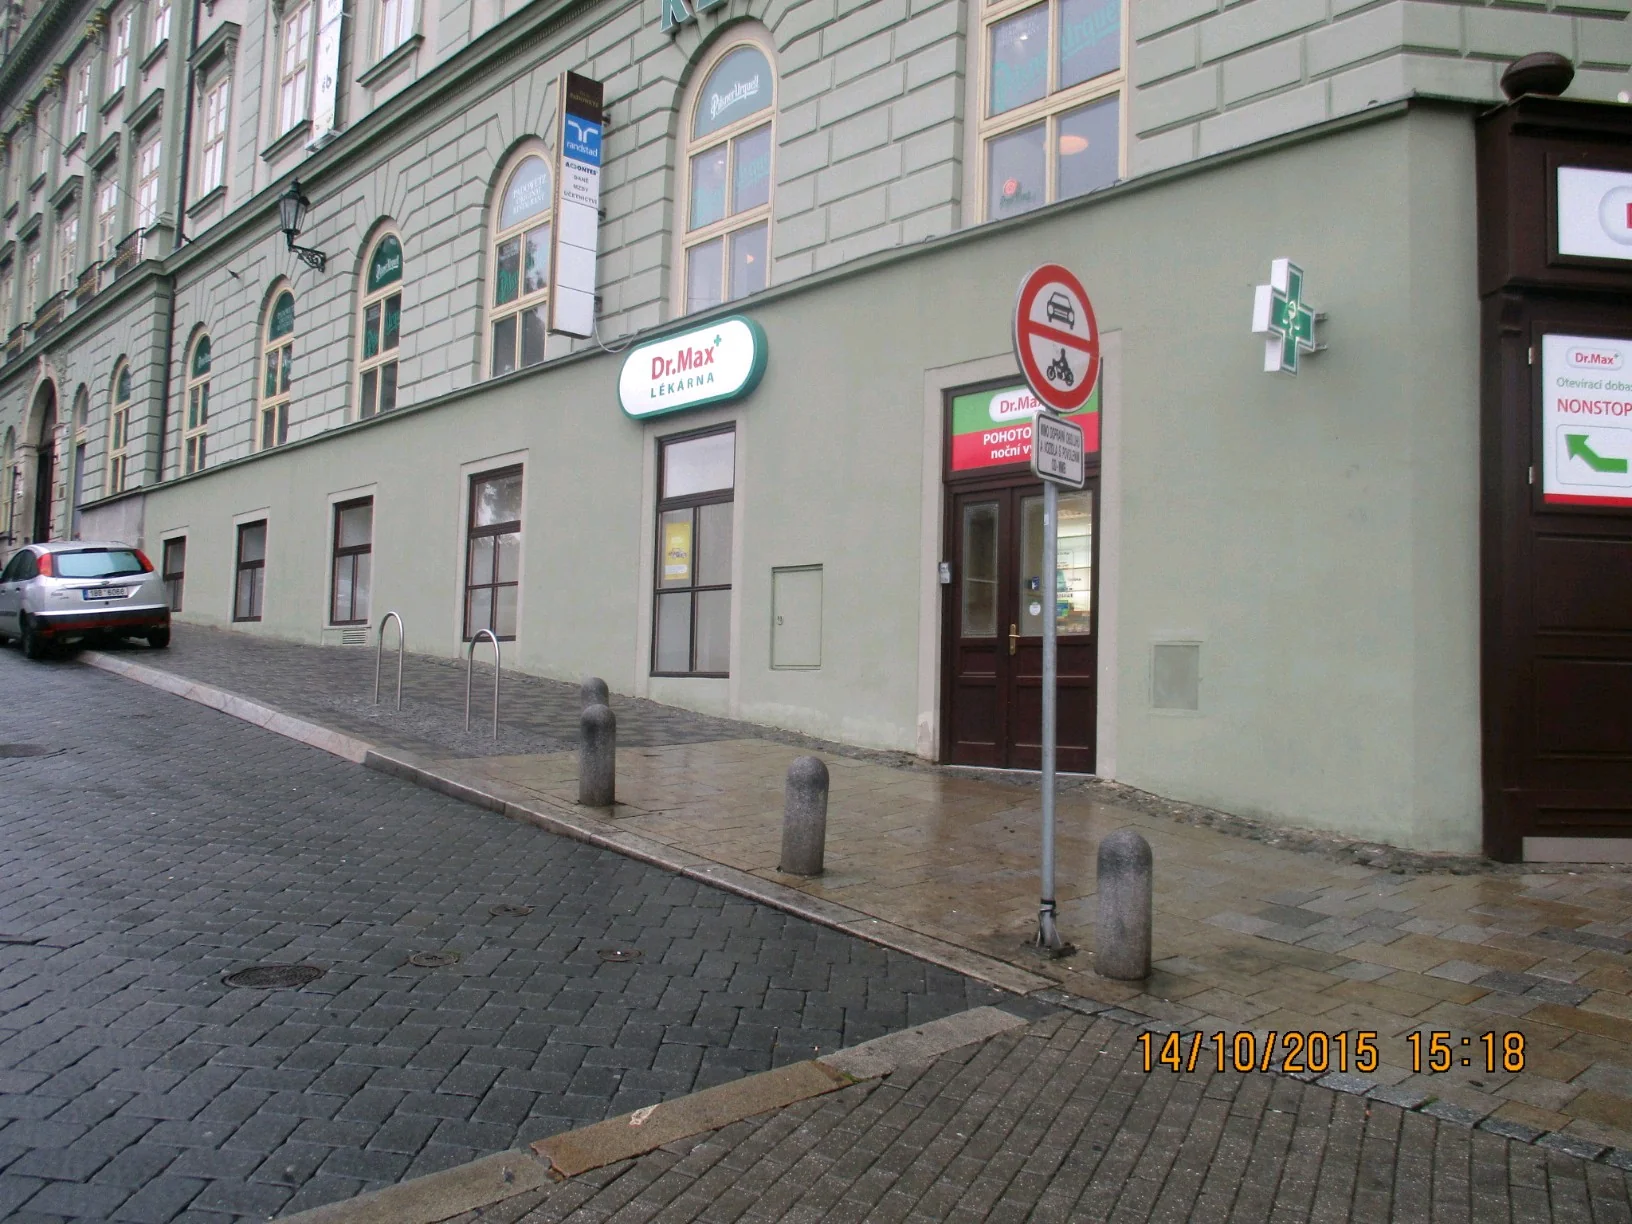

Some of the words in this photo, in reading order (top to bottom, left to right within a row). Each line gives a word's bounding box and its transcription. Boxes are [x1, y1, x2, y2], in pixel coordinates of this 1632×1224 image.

[566, 141, 598, 157] randstad
[651, 346, 715, 380] Dr.Max
[1575, 352, 1615, 365] Dr.Max
[650, 372, 715, 398] LÉKÁRNA
[1557, 398, 1632, 416] NONSTOP
[991, 443, 1021, 459] noční
